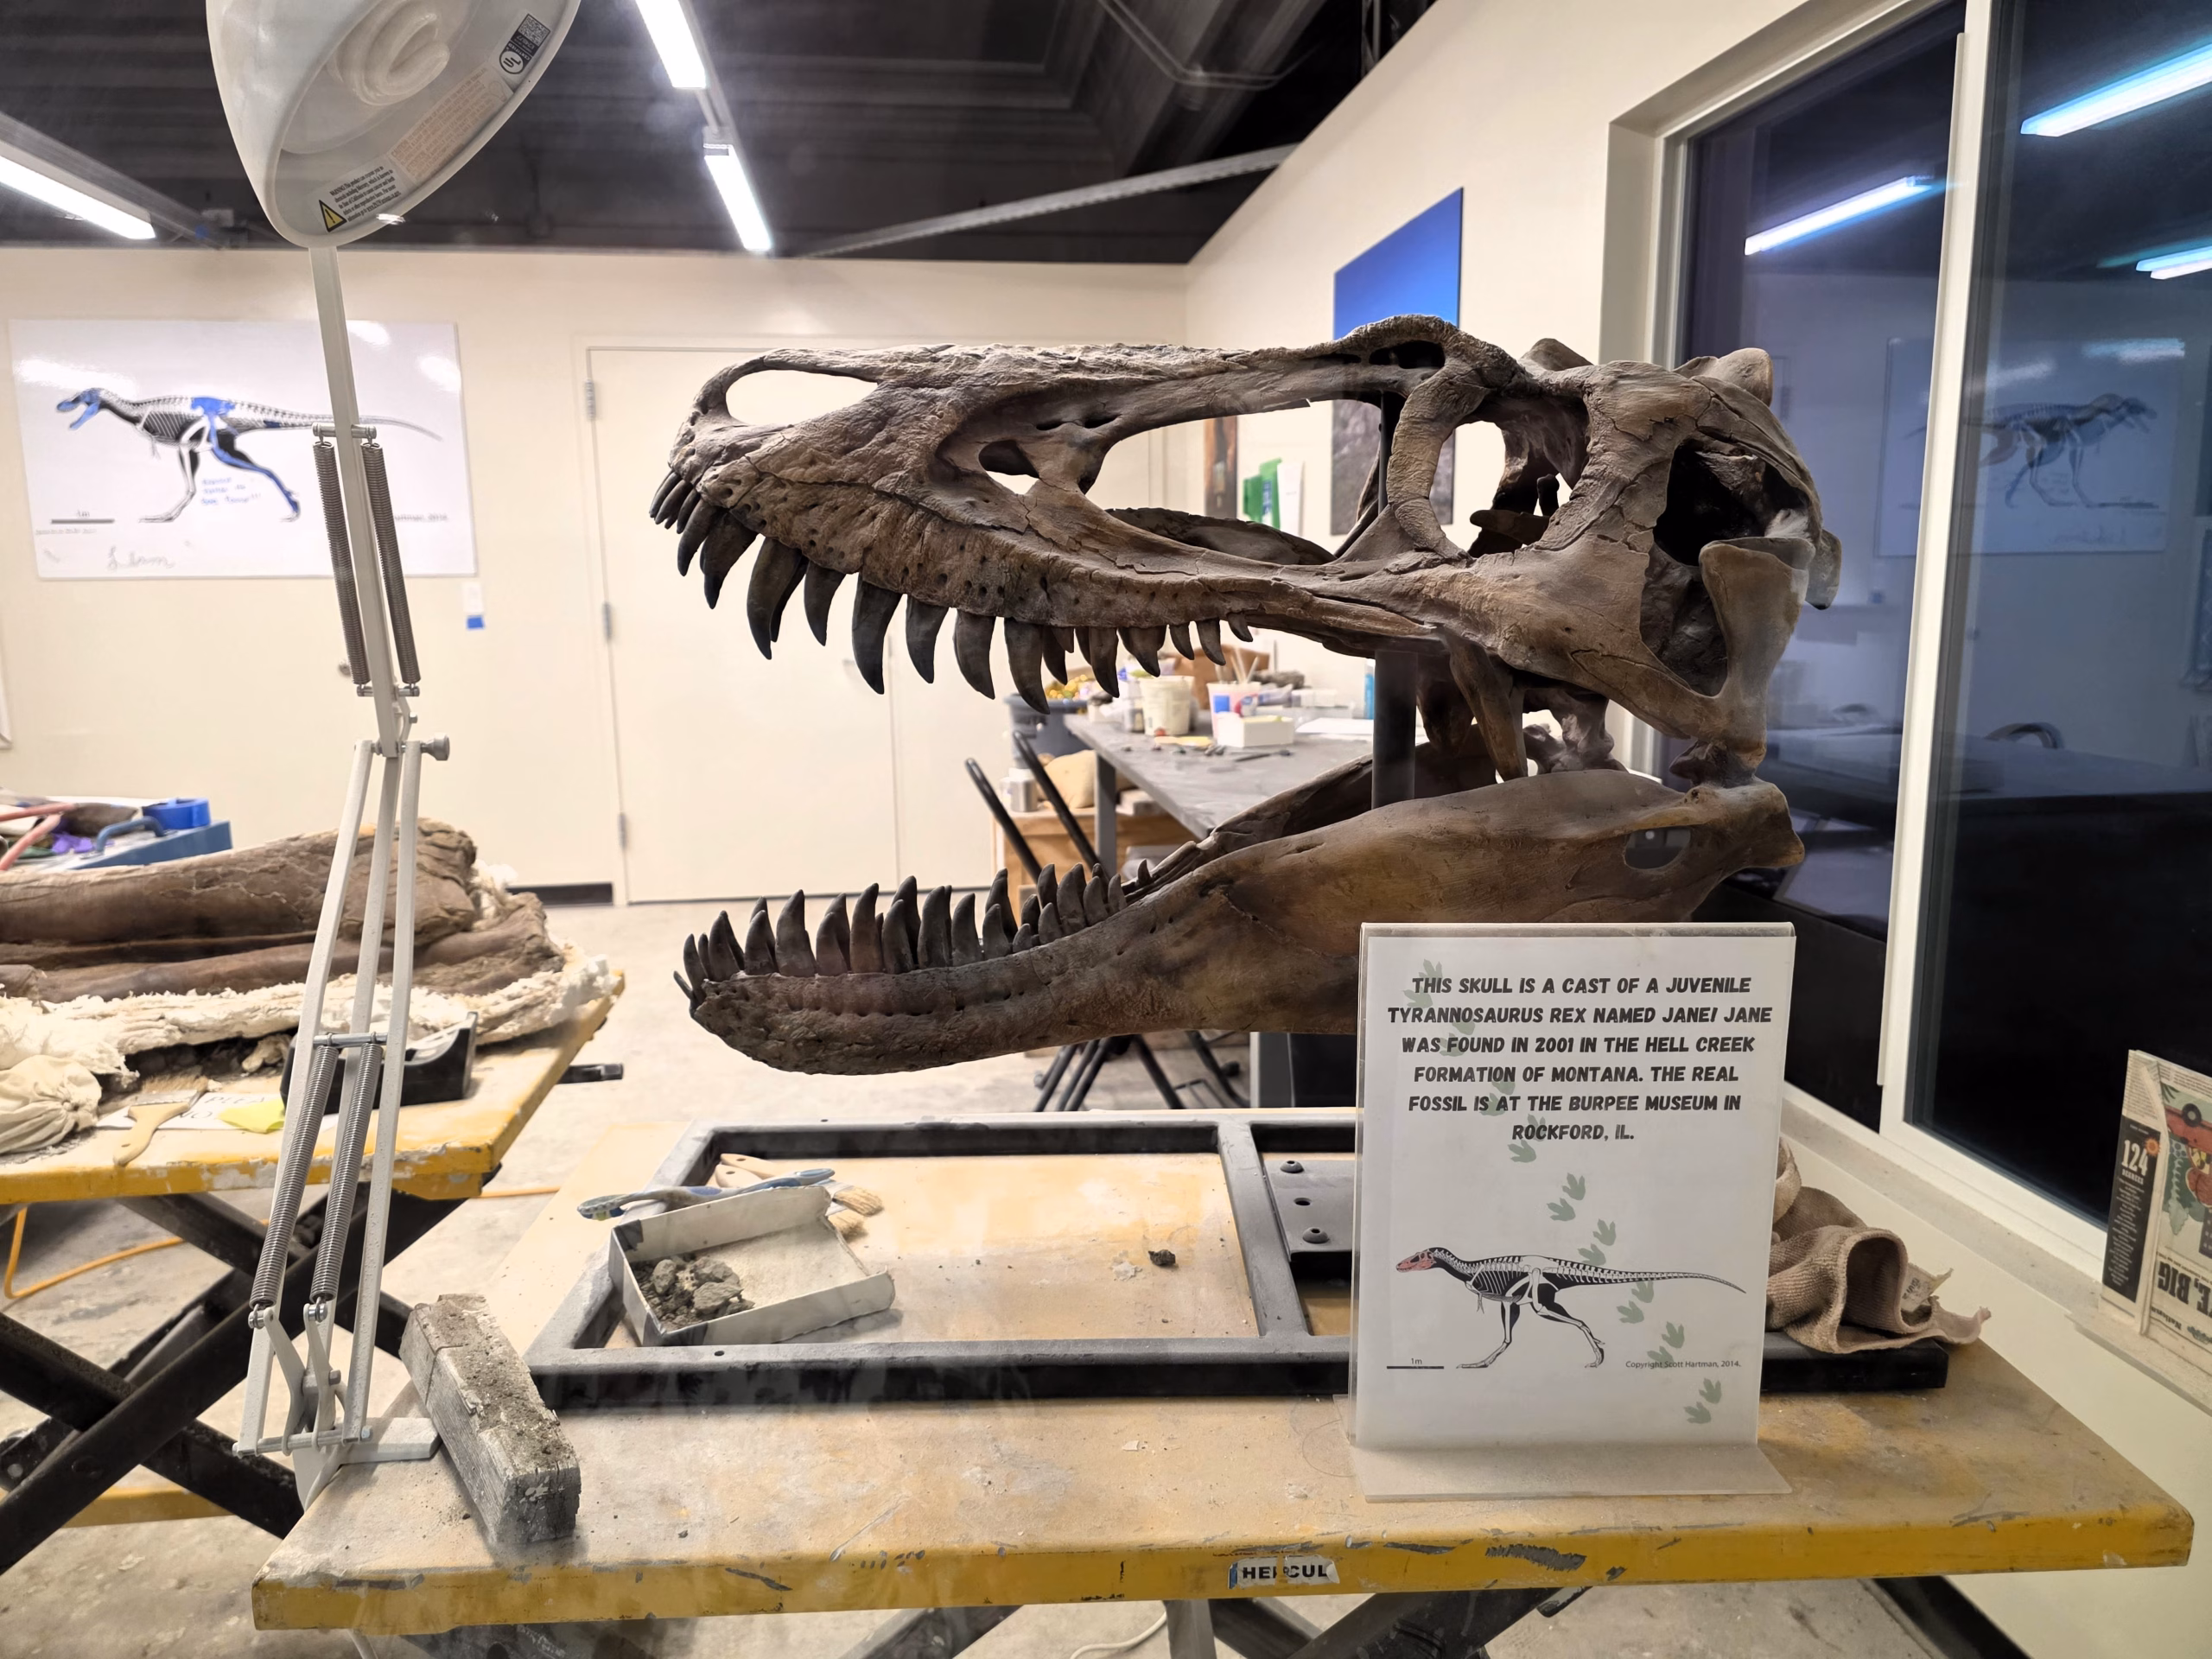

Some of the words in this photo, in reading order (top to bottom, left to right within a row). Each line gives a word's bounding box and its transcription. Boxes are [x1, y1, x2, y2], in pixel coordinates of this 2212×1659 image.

[1412, 977, 1452, 994] THIS
[1459, 977, 1513, 994] SKULL
[1519, 977, 1535, 994] IS
[1541, 977, 1554, 994] A
[1561, 977, 1610, 994] CAST
[1617, 977, 1640, 994] OF
[1645, 977, 1659, 994] A
[1665, 977, 1751, 994] JUVENILE
[1388, 1007, 1544, 1023] TYRANNOSAURUS
[1549, 1007, 1587, 1023] REX
[1592, 1007, 1656, 1023] NAMED
[1662, 1007, 1719, 1023] JANE!
[1723, 1007, 1773, 1023] JANE
[1402, 1037, 1441, 1052] WAS
[1446, 1037, 1505, 1053] FOUND
[1510, 1037, 1529, 1052] IN
[1535, 1037, 1574, 1053] 2001
[1580, 1037, 1598, 1052] IN
[1604, 1037, 1640, 1053] THE
[1644, 1036, 1689, 1052] HELL
[1695, 1036, 1756, 1052] CREEK
[1414, 1066, 1516, 1083] FORMATION
[1522, 1066, 1546, 1083] OF
[1551, 1066, 1643, 1083] MONTANA.
[1650, 1065, 1686, 1082] THE
[1691, 1065, 1738, 1082] REAL
[1408, 1096, 1467, 1112] FOSSIL
[1473, 1096, 1490, 1111] IS
[1495, 1096, 1521, 1111] AT
[1527, 1096, 1563, 1111] THE
[1568, 1095, 1639, 1111] BURPEE
[1645, 1095, 1718, 1111] MUSEUM
[1723, 1095, 1741, 1110] IN
[1512, 1124, 1609, 1141] ROCKFORD,
[1615, 1124, 1634, 1140] IL.
[2121, 1139, 2148, 1176] 124
[2158, 1261, 2191, 1305] BIG
[1625, 1360, 1662, 1370] Copyright
[1664, 1360, 1683, 1369] Scott
[1685, 1360, 1719, 1369] Hartman,
